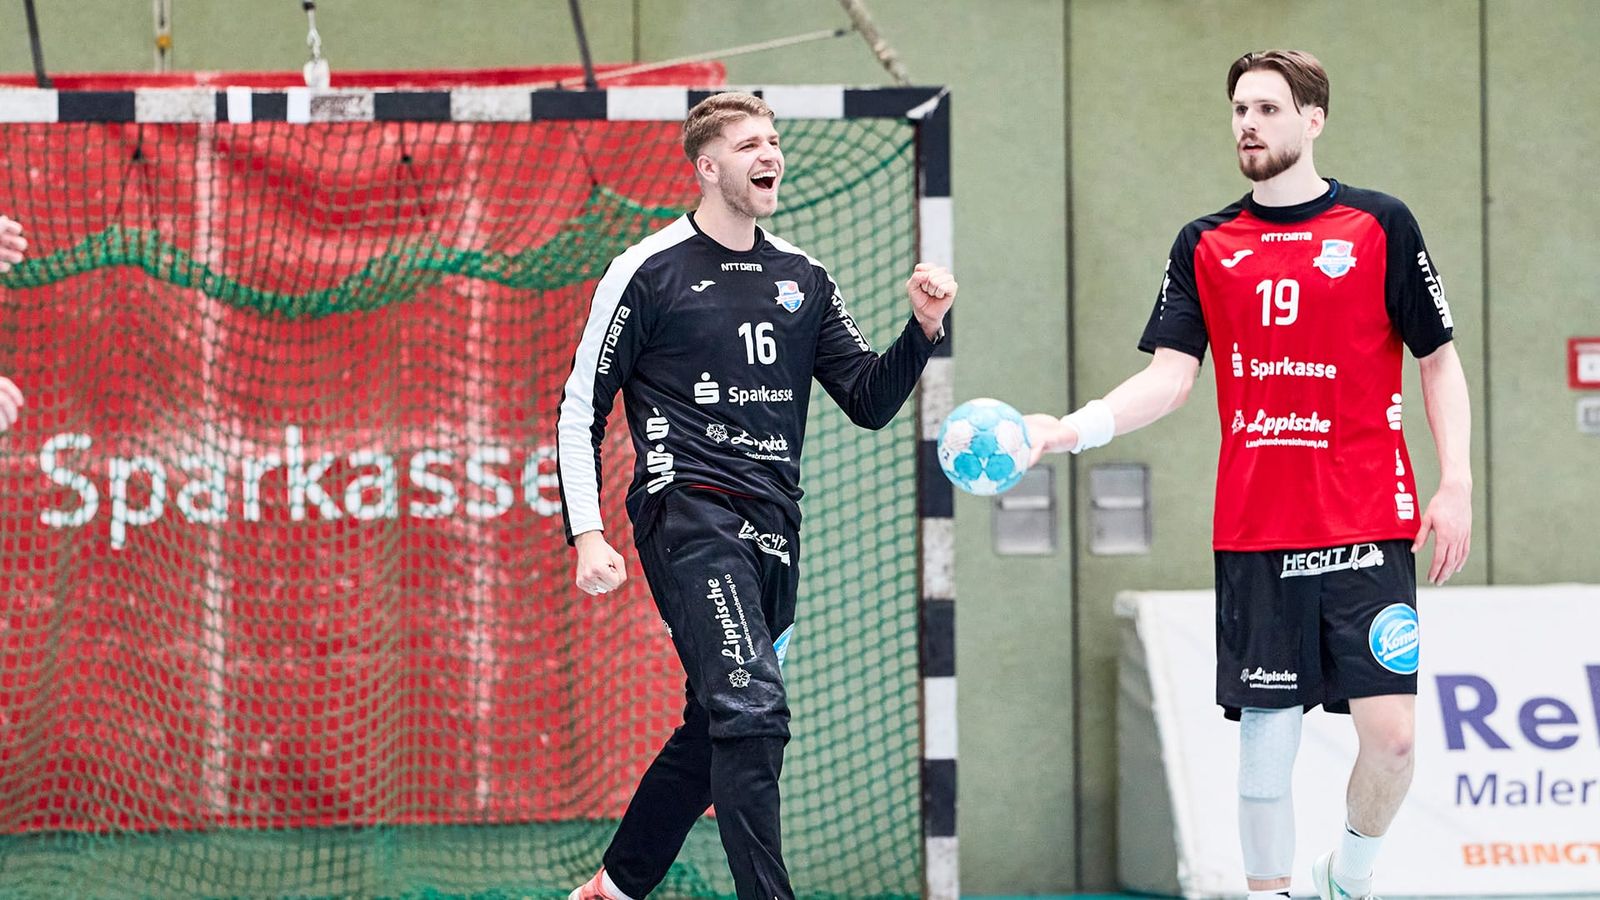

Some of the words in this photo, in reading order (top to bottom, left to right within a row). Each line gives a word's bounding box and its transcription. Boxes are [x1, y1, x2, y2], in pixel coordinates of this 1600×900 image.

[1256, 278, 1300, 327] 19
[737, 321, 778, 365] 16
[1250, 356, 1337, 381] Sparkasse
[727, 385, 794, 407] Sparkasse
[1246, 408, 1332, 436] Lppische
[39, 425, 561, 550] Sparkasse
[1283, 547, 1347, 572] HECHT
[706, 578, 745, 665] Lippische
[1456, 769, 1598, 806] Maler
